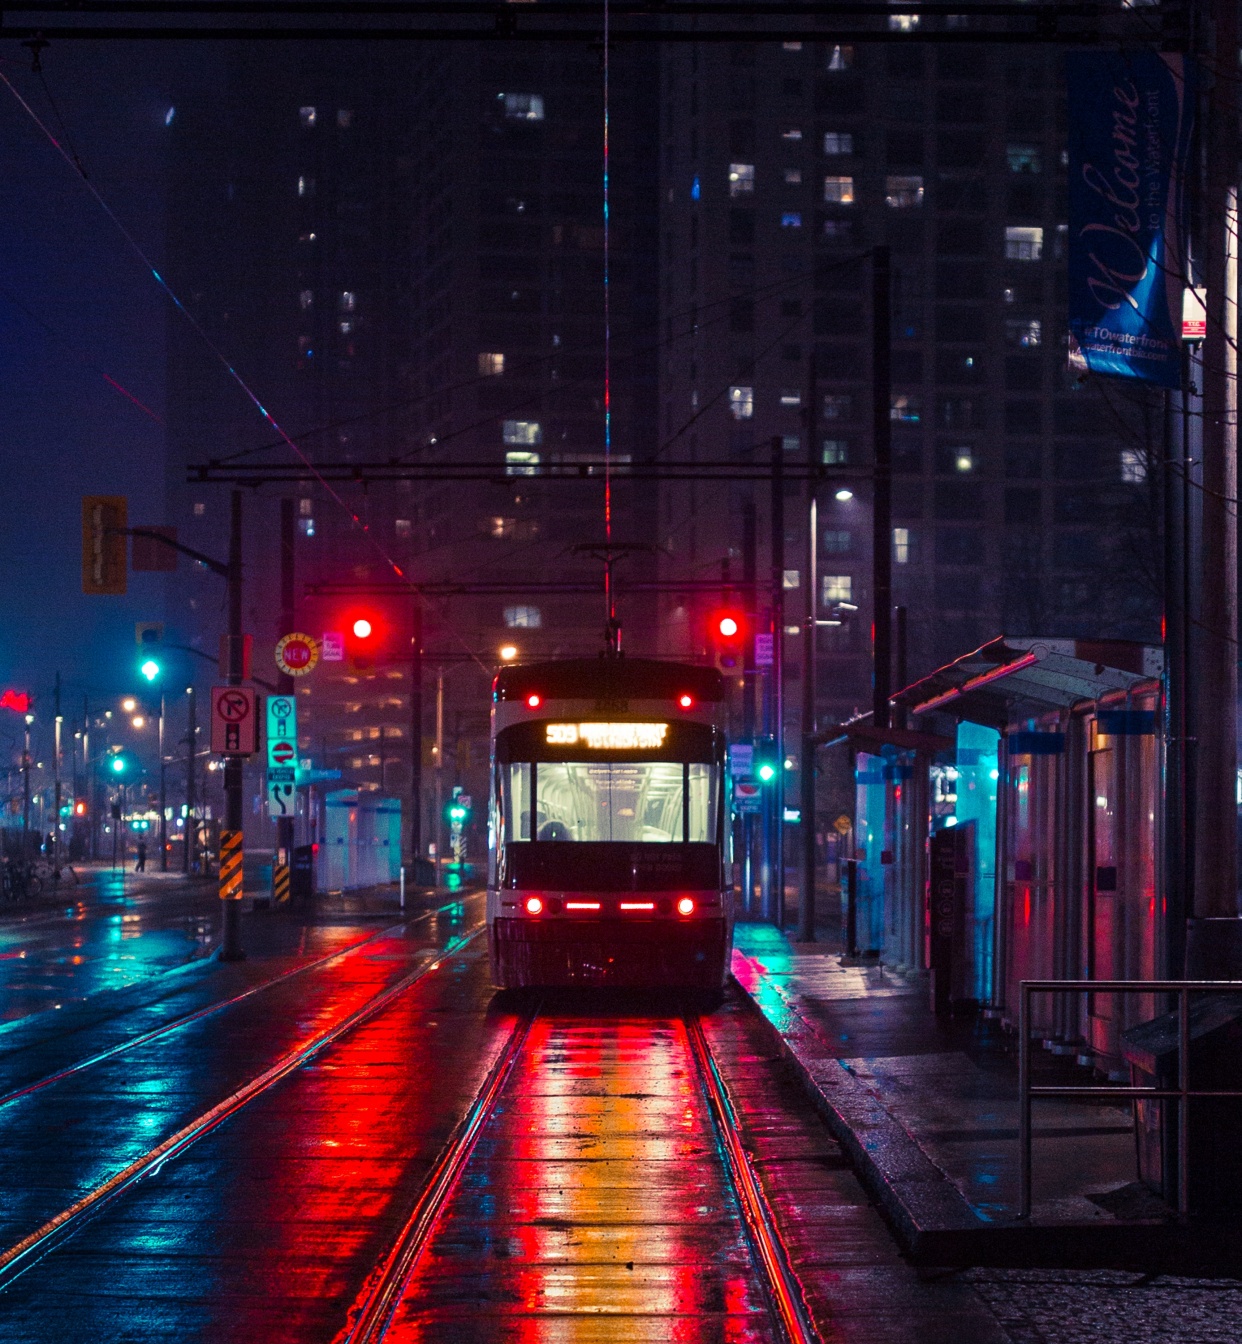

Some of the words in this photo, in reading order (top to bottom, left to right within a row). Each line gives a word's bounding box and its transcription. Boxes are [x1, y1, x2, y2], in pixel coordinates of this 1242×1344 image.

[1079, 78, 1147, 309] Welcome
[1145, 181, 1160, 206] the
[1146, 213, 1160, 230] to
[284, 648, 309, 661] NEW
[546, 723, 577, 743] 509
